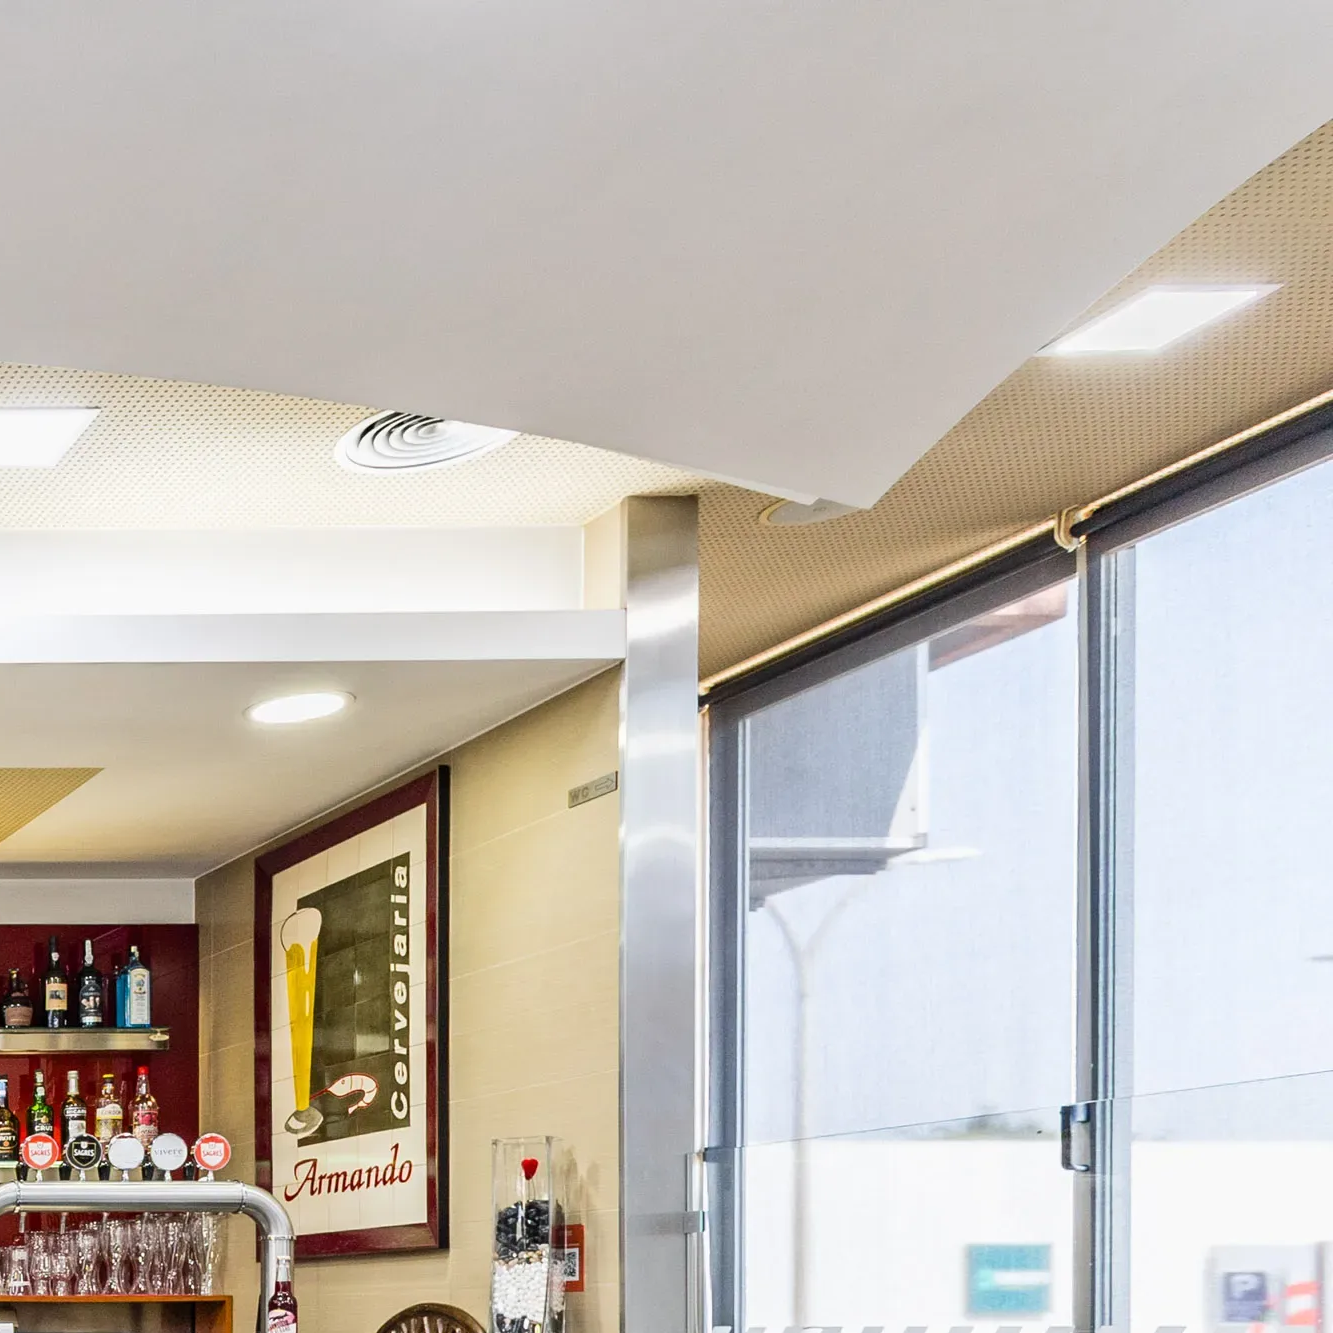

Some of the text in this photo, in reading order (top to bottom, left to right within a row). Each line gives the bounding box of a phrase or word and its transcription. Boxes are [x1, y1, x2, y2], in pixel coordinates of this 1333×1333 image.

[569, 786, 590, 803] WC
[390, 864, 410, 1120] Cervejaria
[30, 1148, 51, 1157] SAGRES
[74, 1147, 95, 1157] SAGRES
[203, 1148, 223, 1157] SAGRES
[283, 1143, 413, 1203] Armando
